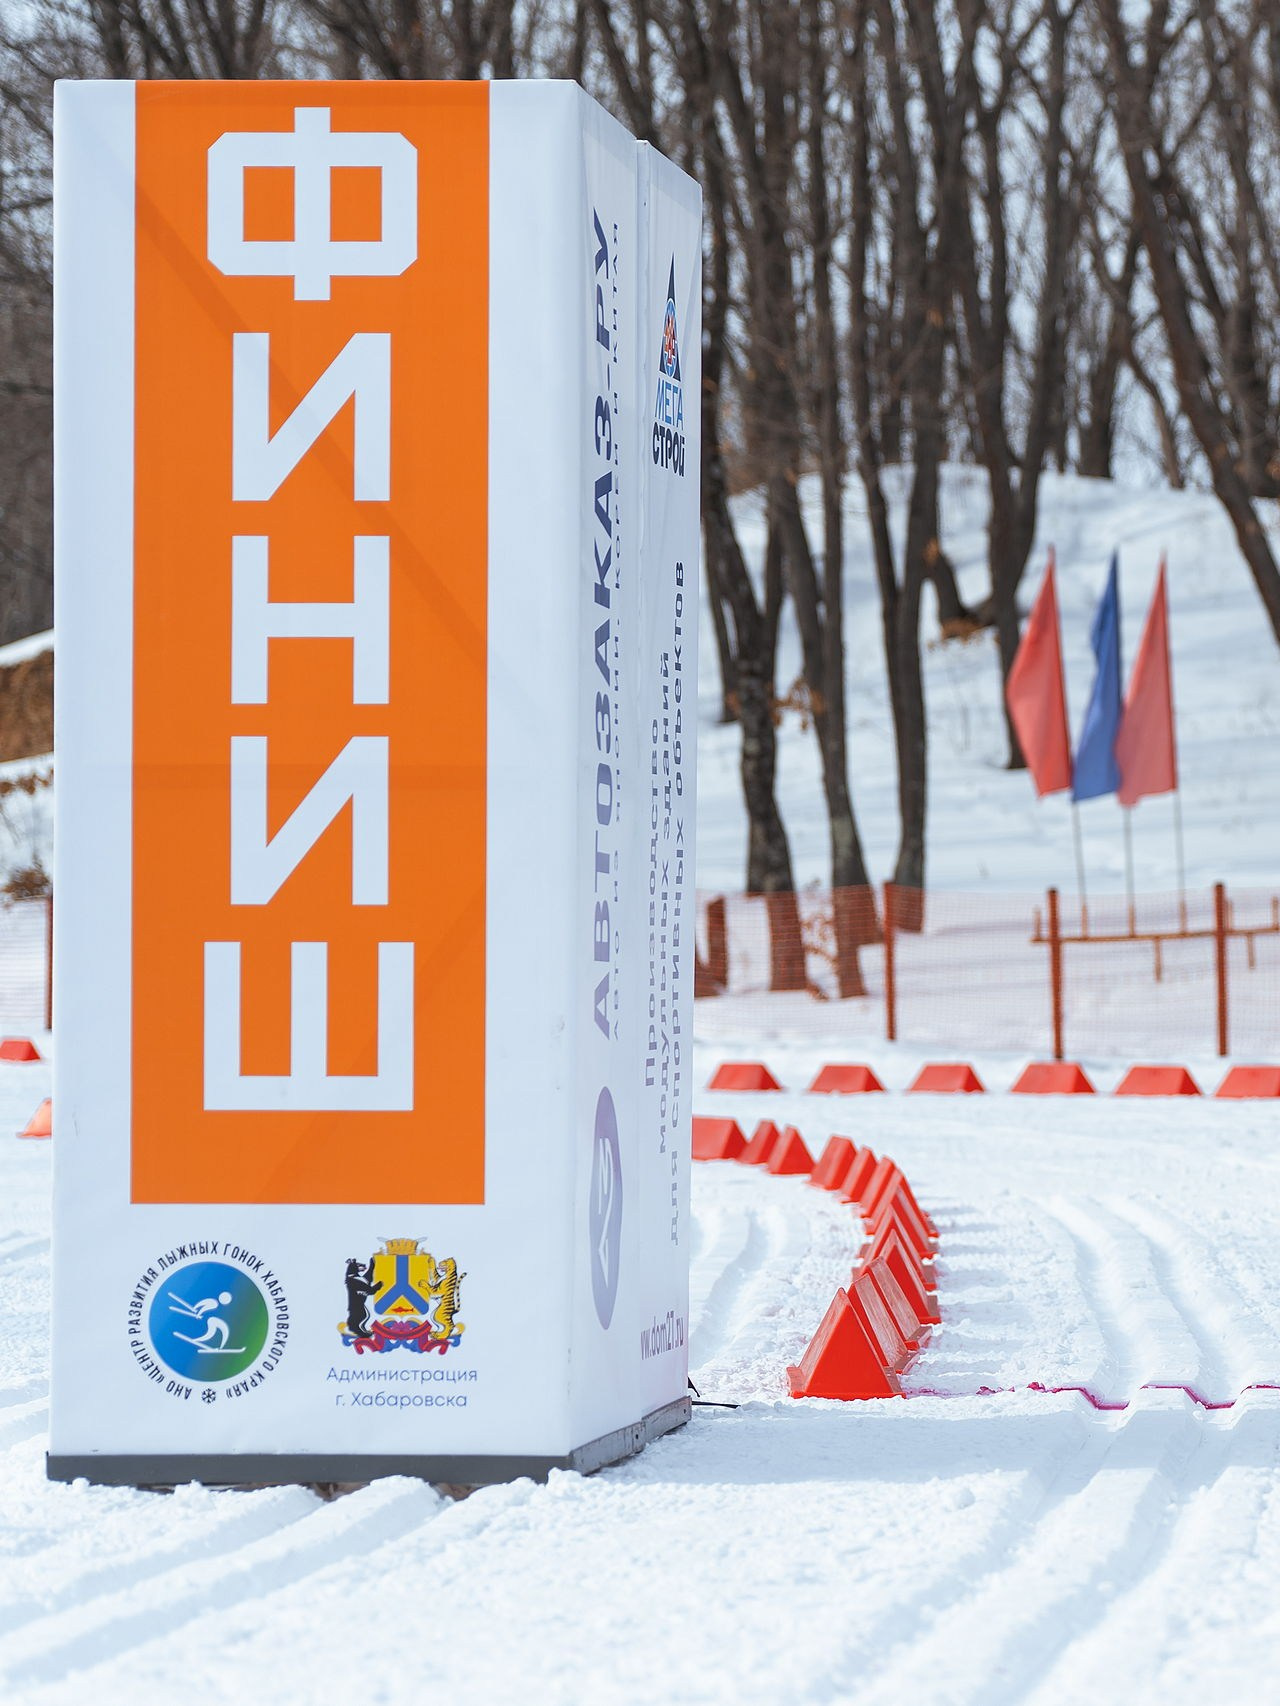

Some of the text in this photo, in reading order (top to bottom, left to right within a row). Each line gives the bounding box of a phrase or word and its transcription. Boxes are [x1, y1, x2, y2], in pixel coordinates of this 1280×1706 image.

[655, 377, 684, 431] МЕГА
[652, 421, 685, 477] СТРОЙ
[204, 107, 418, 1111] ФИНИШ
[645, 719, 658, 1087] Производство
[659, 652, 671, 1154] модульных зданий
[671, 562, 684, 1246] для спортивных объектов
[157, 1241, 219, 1271] ЛЫЖНЫХ
[223, 1243, 265, 1273] ГОНОК
[128, 1267, 159, 1335] РАЗВИТИЯ
[261, 1270, 290, 1371] ХАБАРОВСКОГО
[165, 1380, 193, 1400] АНО
[326, 1367, 478, 1384] Администрация
[335, 1391, 467, 1409] г. Хабаровска
